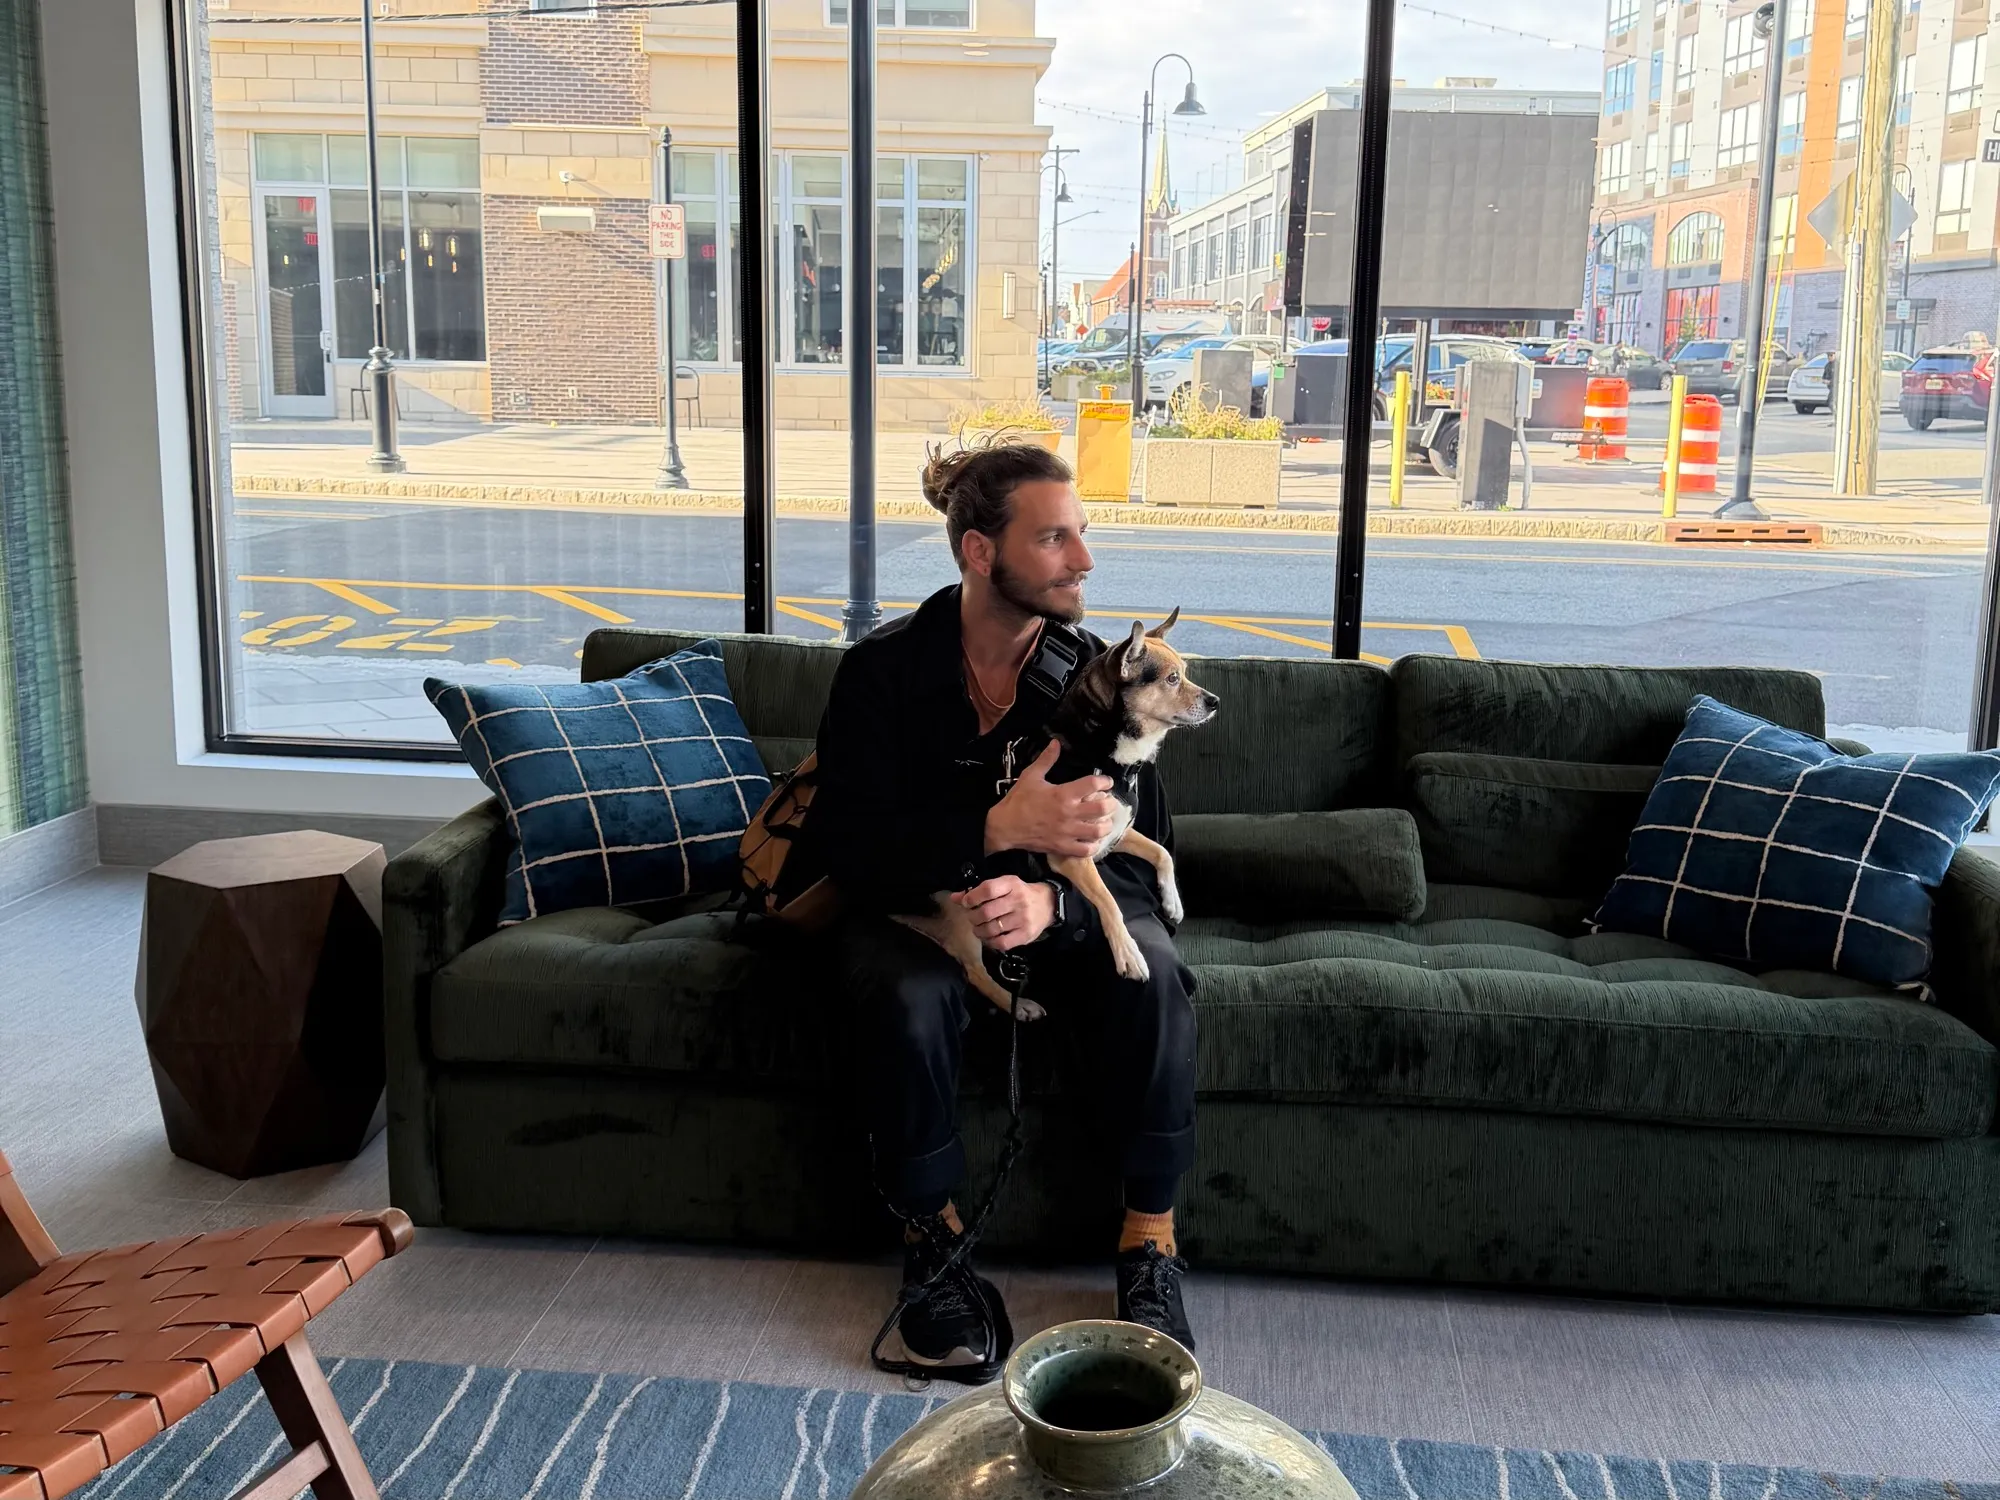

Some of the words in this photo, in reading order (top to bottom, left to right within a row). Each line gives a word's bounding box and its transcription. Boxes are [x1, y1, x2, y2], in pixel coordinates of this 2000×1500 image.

[660, 209, 673, 221] NO
[651, 221, 682, 231] PARKING
[659, 231, 675, 239] THIS
[659, 240, 675, 248] SIDE
